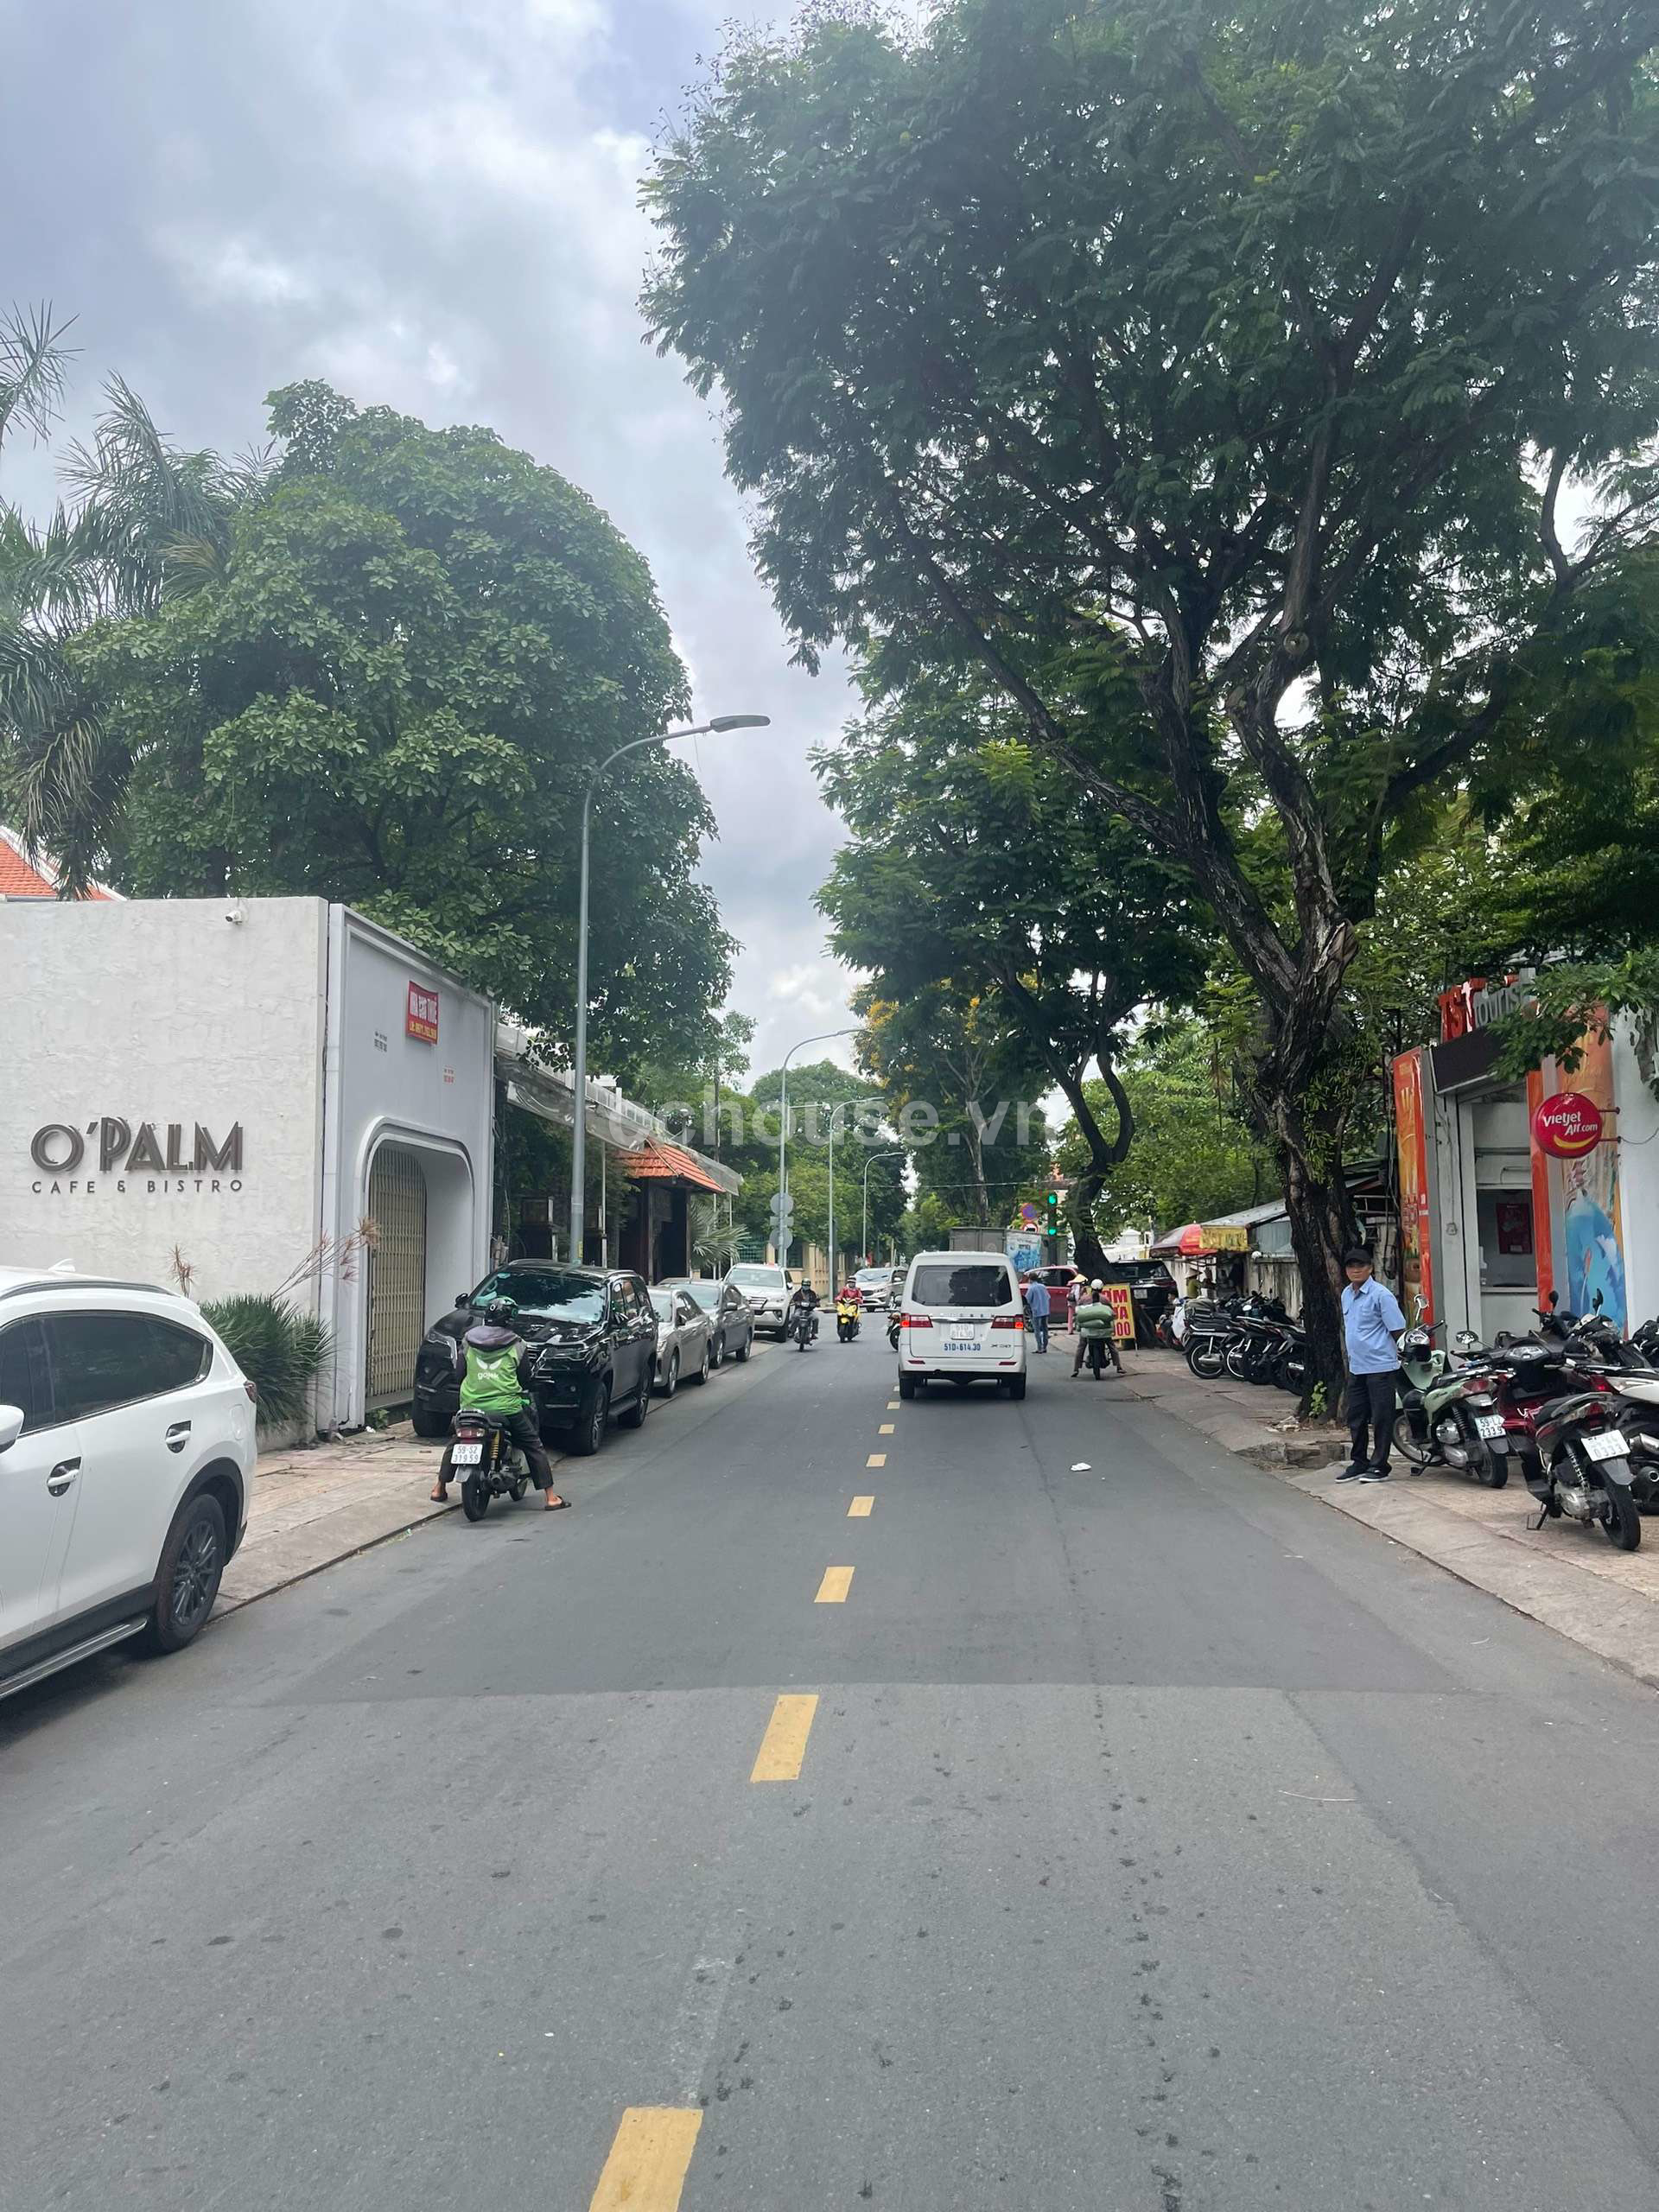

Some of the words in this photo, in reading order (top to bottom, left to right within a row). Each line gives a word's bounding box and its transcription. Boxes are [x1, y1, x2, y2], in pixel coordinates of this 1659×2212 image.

[30, 1116, 244, 1173] O'PALM
[32, 1180, 96, 1194] CAFE
[117, 1180, 126, 1193] &
[147, 1179, 243, 1193] BISTRO
[477, 1371, 499, 1381] gojek
